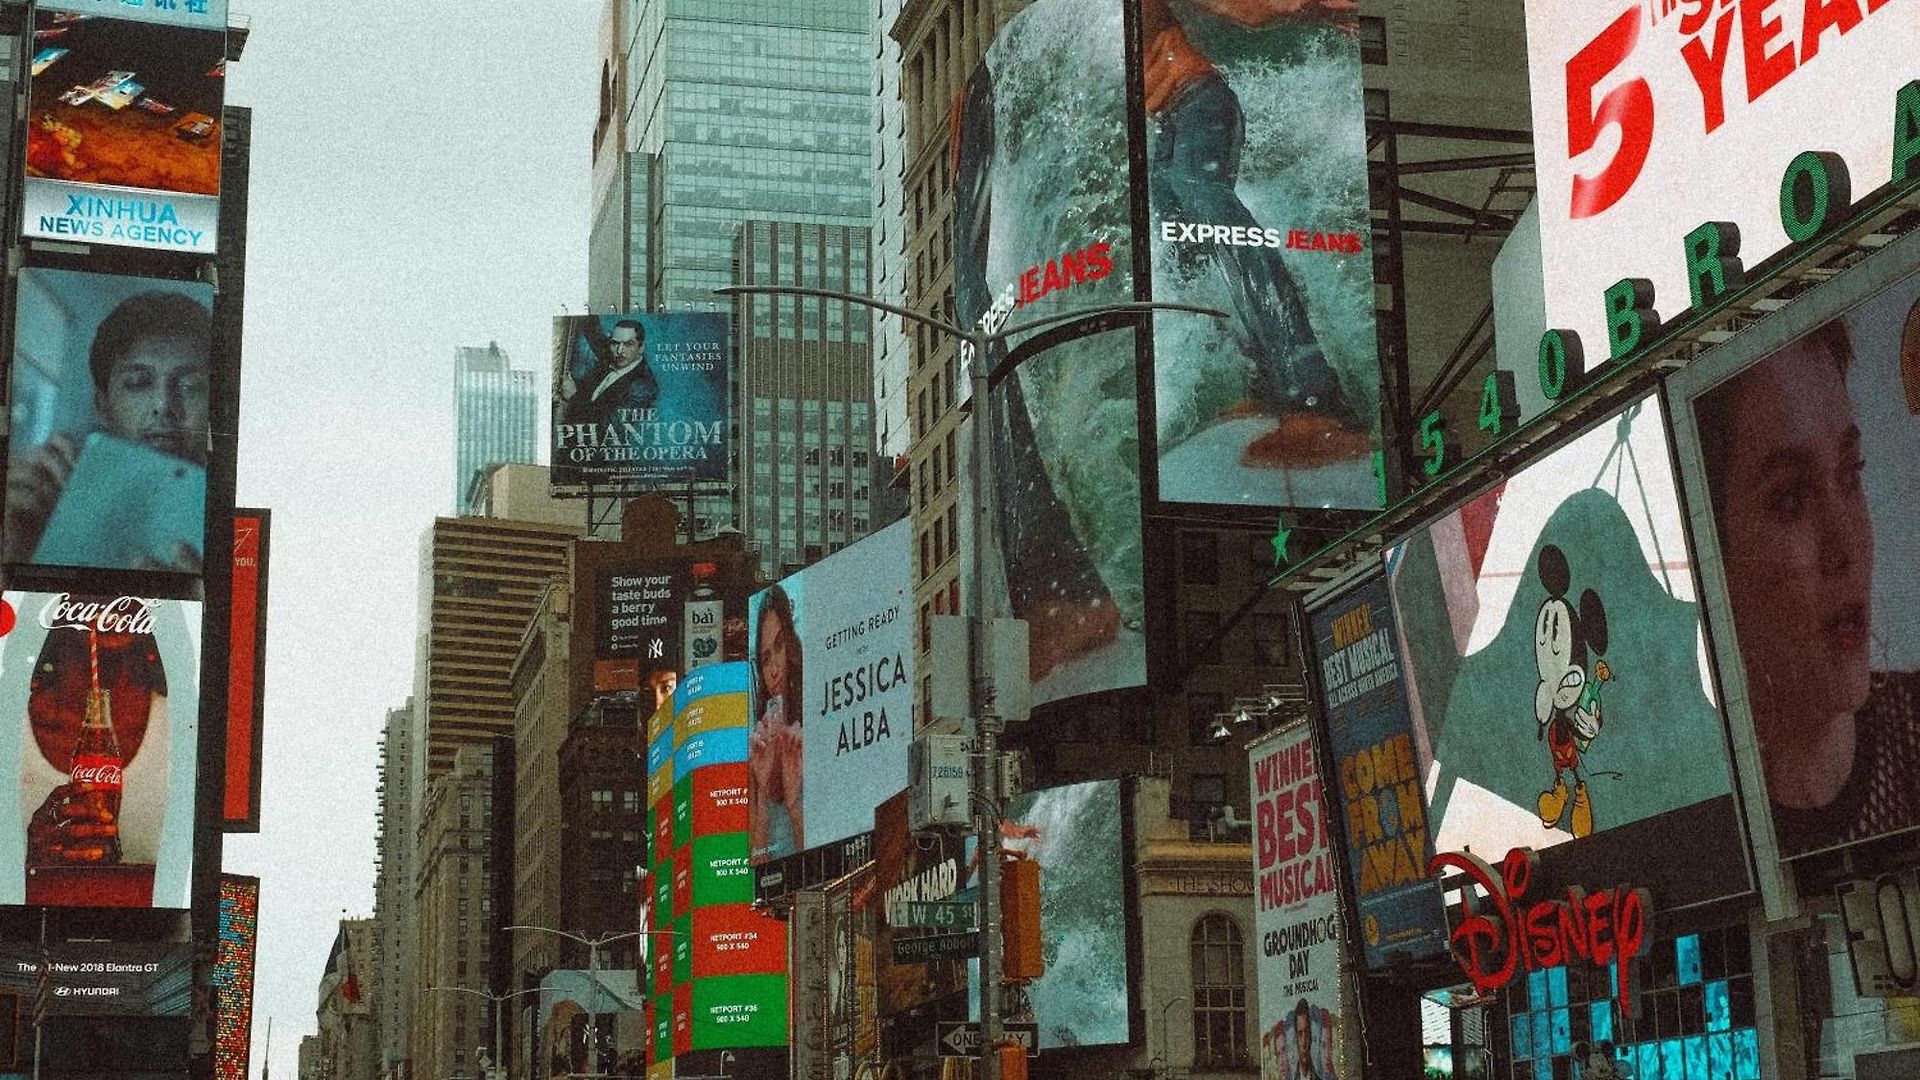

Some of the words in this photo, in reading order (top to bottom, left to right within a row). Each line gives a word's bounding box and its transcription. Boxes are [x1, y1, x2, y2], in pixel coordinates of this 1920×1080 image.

[1566, 4, 1655, 220] 5
[66, 194, 178, 226] XINHUA
[40, 216, 104, 237] NEWS
[111, 223, 202, 247] AGENCY
[1161, 220, 1280, 248] EXPRESS
[1285, 228, 1362, 255] JEANS
[1017, 242, 1114, 311] JEANS
[656, 343, 679, 352] LET
[686, 342, 720, 352] YOUR
[655, 352, 722, 362] FANTASIES
[662, 362, 714, 372] UNWIND
[618, 407, 660, 422] THE
[556, 420, 723, 449] PHANTOM
[571, 448, 596, 463] OF
[601, 448, 640, 462] THE
[643, 446, 708, 462] OPERA
[612, 576, 642, 588] Show
[644, 575, 672, 588] your
[612, 590, 641, 601] taste
[643, 588, 671, 600] buds
[39, 592, 163, 635] Coca-Cola
[613, 605, 619, 613] a
[622, 602, 656, 614] berry
[692, 608, 714, 624] bai
[612, 615, 640, 630] good
[641, 614, 667, 626] time
[826, 620, 866, 650] GETTING
[868, 605, 901, 631] READY
[1323, 649, 1348, 691] BEST
[1347, 627, 1394, 679] MUSICAL
[821, 651, 907, 717] JESSICA
[836, 706, 890, 757] ALBA
[1256, 738, 1318, 797] WINNE
[1341, 732, 1415, 799] COME
[710, 788, 742, 798] NETPORT
[1348, 778, 1424, 850] FROM
[1256, 779, 1329, 870] BEST
[710, 858, 742, 868] NETPORT
[1359, 832, 1426, 897] AWAY
[912, 904, 927, 925] W
[935, 904, 955, 925] 45
[710, 933, 742, 942] NETPORT
[1264, 914, 1337, 957] GROUNDHOG
[897, 940, 936, 957] George
[17, 963, 37, 973] The
[80, 963, 105, 973] 2018
[106, 963, 142, 973] Elantra
[144, 963, 159, 973] GT
[1289, 949, 1310, 979] DAY
[73, 987, 120, 996] HYUNDAI
[1295, 978, 1319, 995] MUSICAL
[710, 1005, 742, 1014] NETPORT
[953, 1033, 981, 1046] ONE
